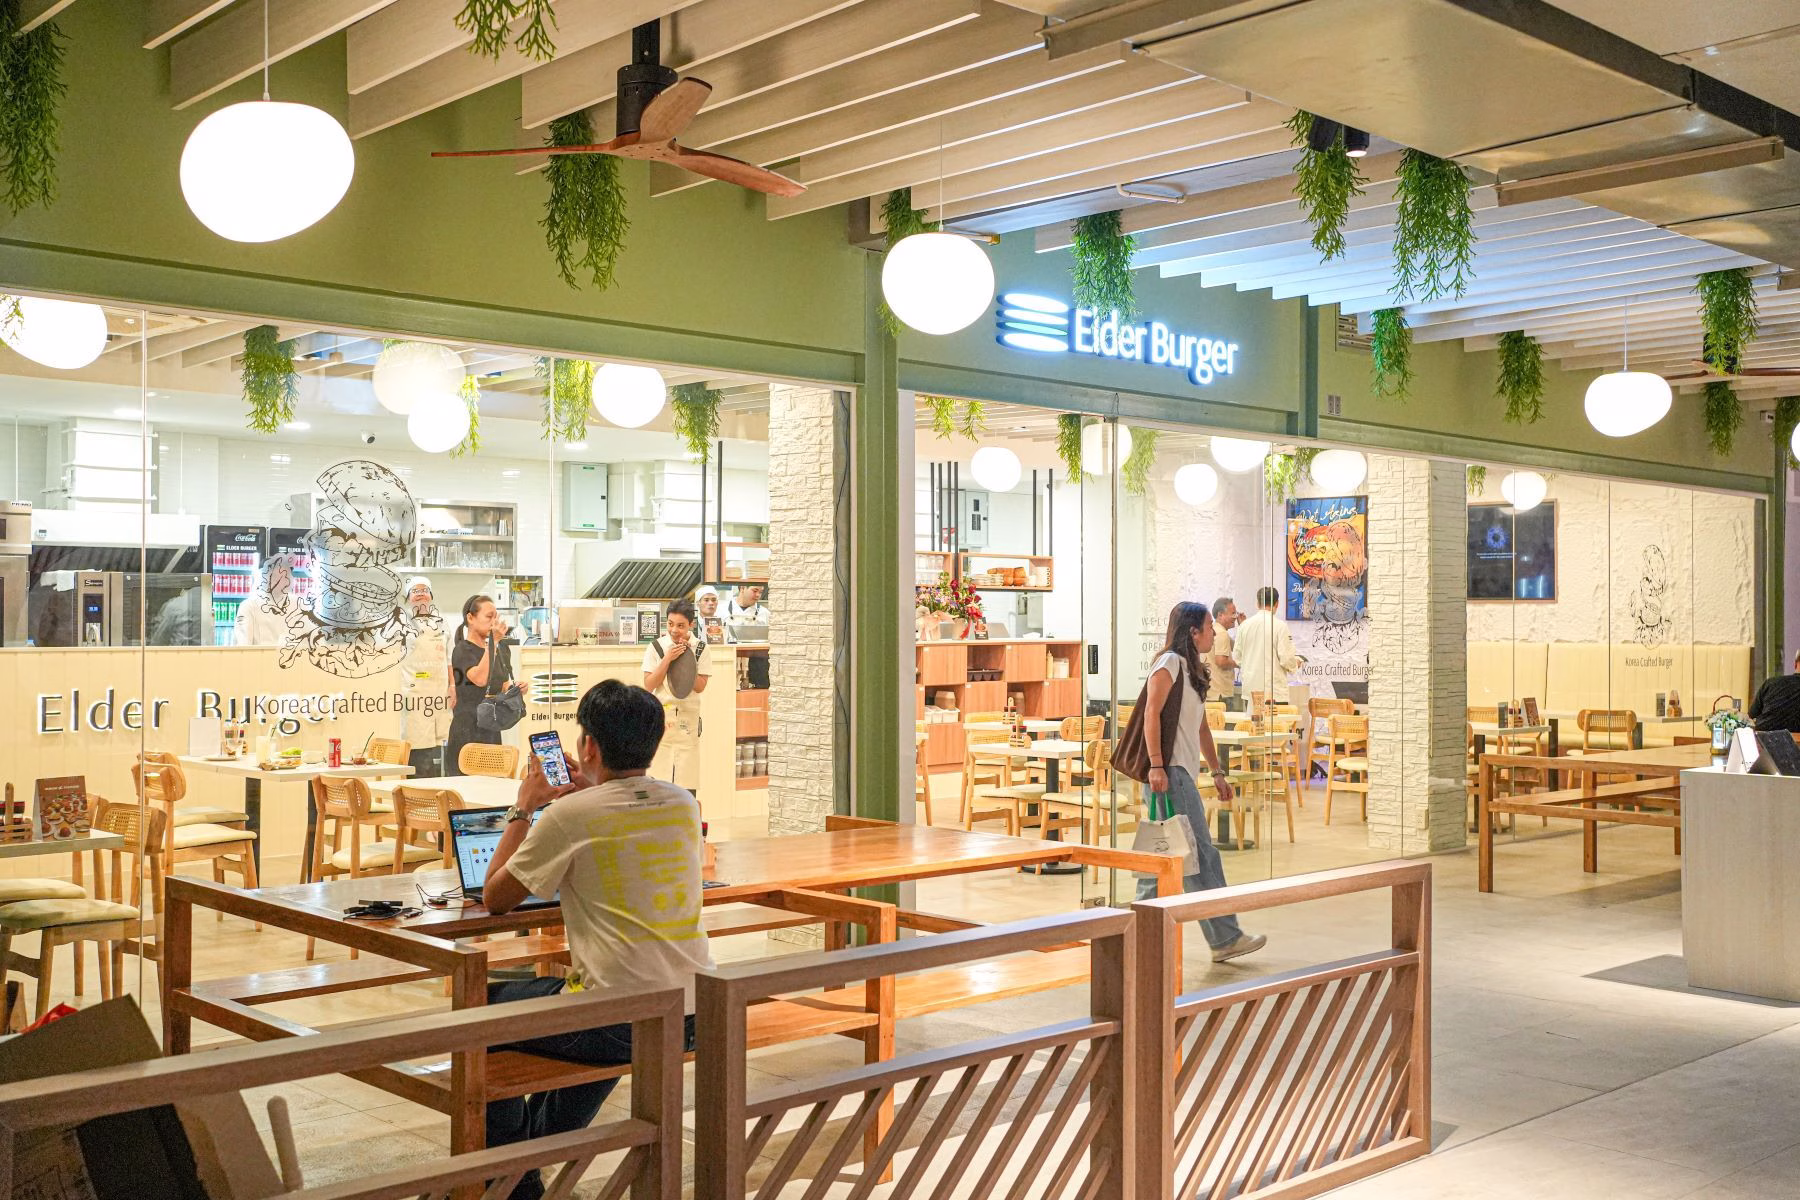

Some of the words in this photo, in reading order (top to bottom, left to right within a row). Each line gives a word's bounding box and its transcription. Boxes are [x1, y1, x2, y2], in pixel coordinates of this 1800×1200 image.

[1073, 308, 1147, 361] Elder
[1150, 322, 1239, 385] Burger
[1302, 665, 1322, 676] Korea
[1325, 663, 1350, 676] Crafted
[1353, 664, 1374, 679] Burger
[39, 688, 169, 732] Elder
[254, 695, 310, 715] Korea
[317, 691, 387, 714] Crafted
[393, 693, 452, 717] Burger
